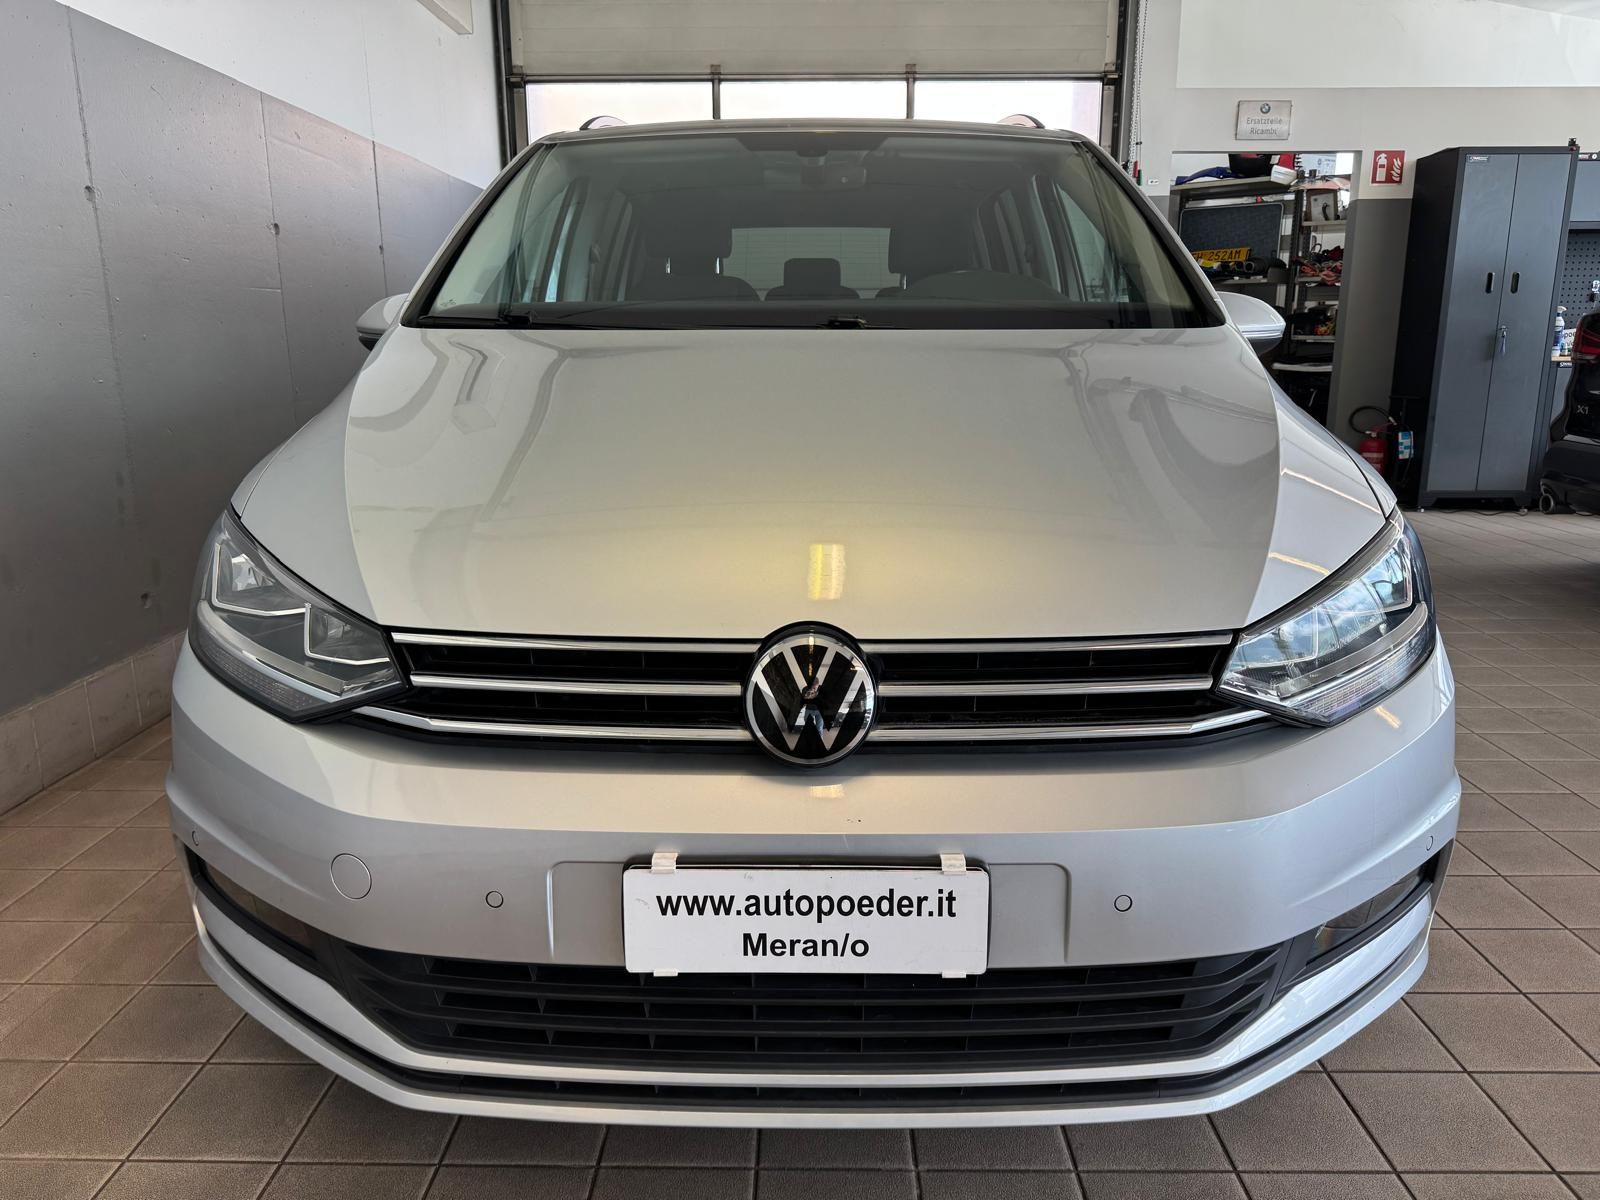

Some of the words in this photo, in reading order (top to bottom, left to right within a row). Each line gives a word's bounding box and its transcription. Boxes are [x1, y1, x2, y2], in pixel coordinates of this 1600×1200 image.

[1247, 117, 1282, 125] Ersatzteile
[1250, 127, 1277, 135] Ricambi
[1577, 405, 1589, 415] X1
[656, 889, 957, 923] www.autopoeder.it
[742, 933, 869, 957] Meran/o
